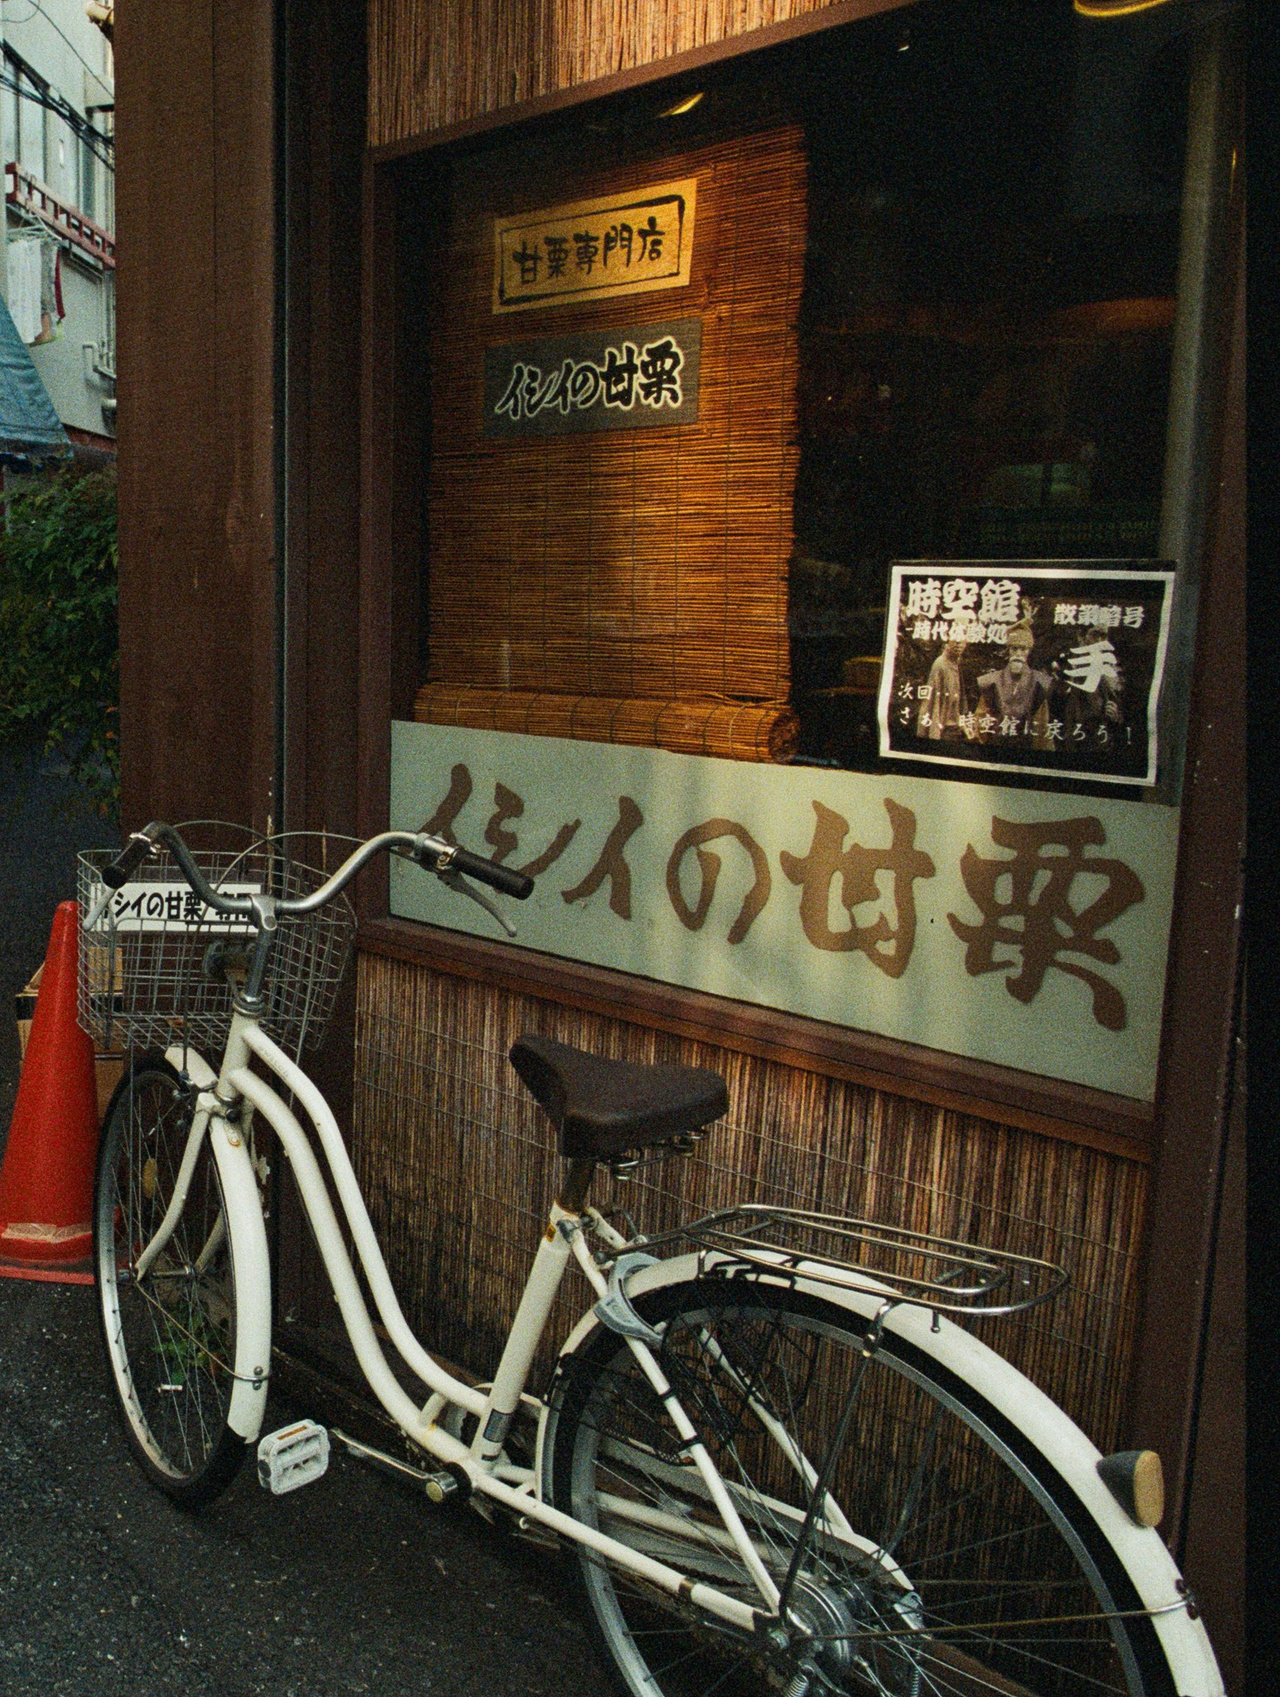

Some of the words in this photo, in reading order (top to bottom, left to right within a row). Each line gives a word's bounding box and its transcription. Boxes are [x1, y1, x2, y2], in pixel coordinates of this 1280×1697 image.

[512, 216, 665, 284] 甘栗専門店
[494, 336, 684, 420] イシイの甘栗
[907, 577, 1021, 622] 時空館
[1063, 640, 1118, 692] 手
[394, 763, 1146, 1031] イシイの甘栗
